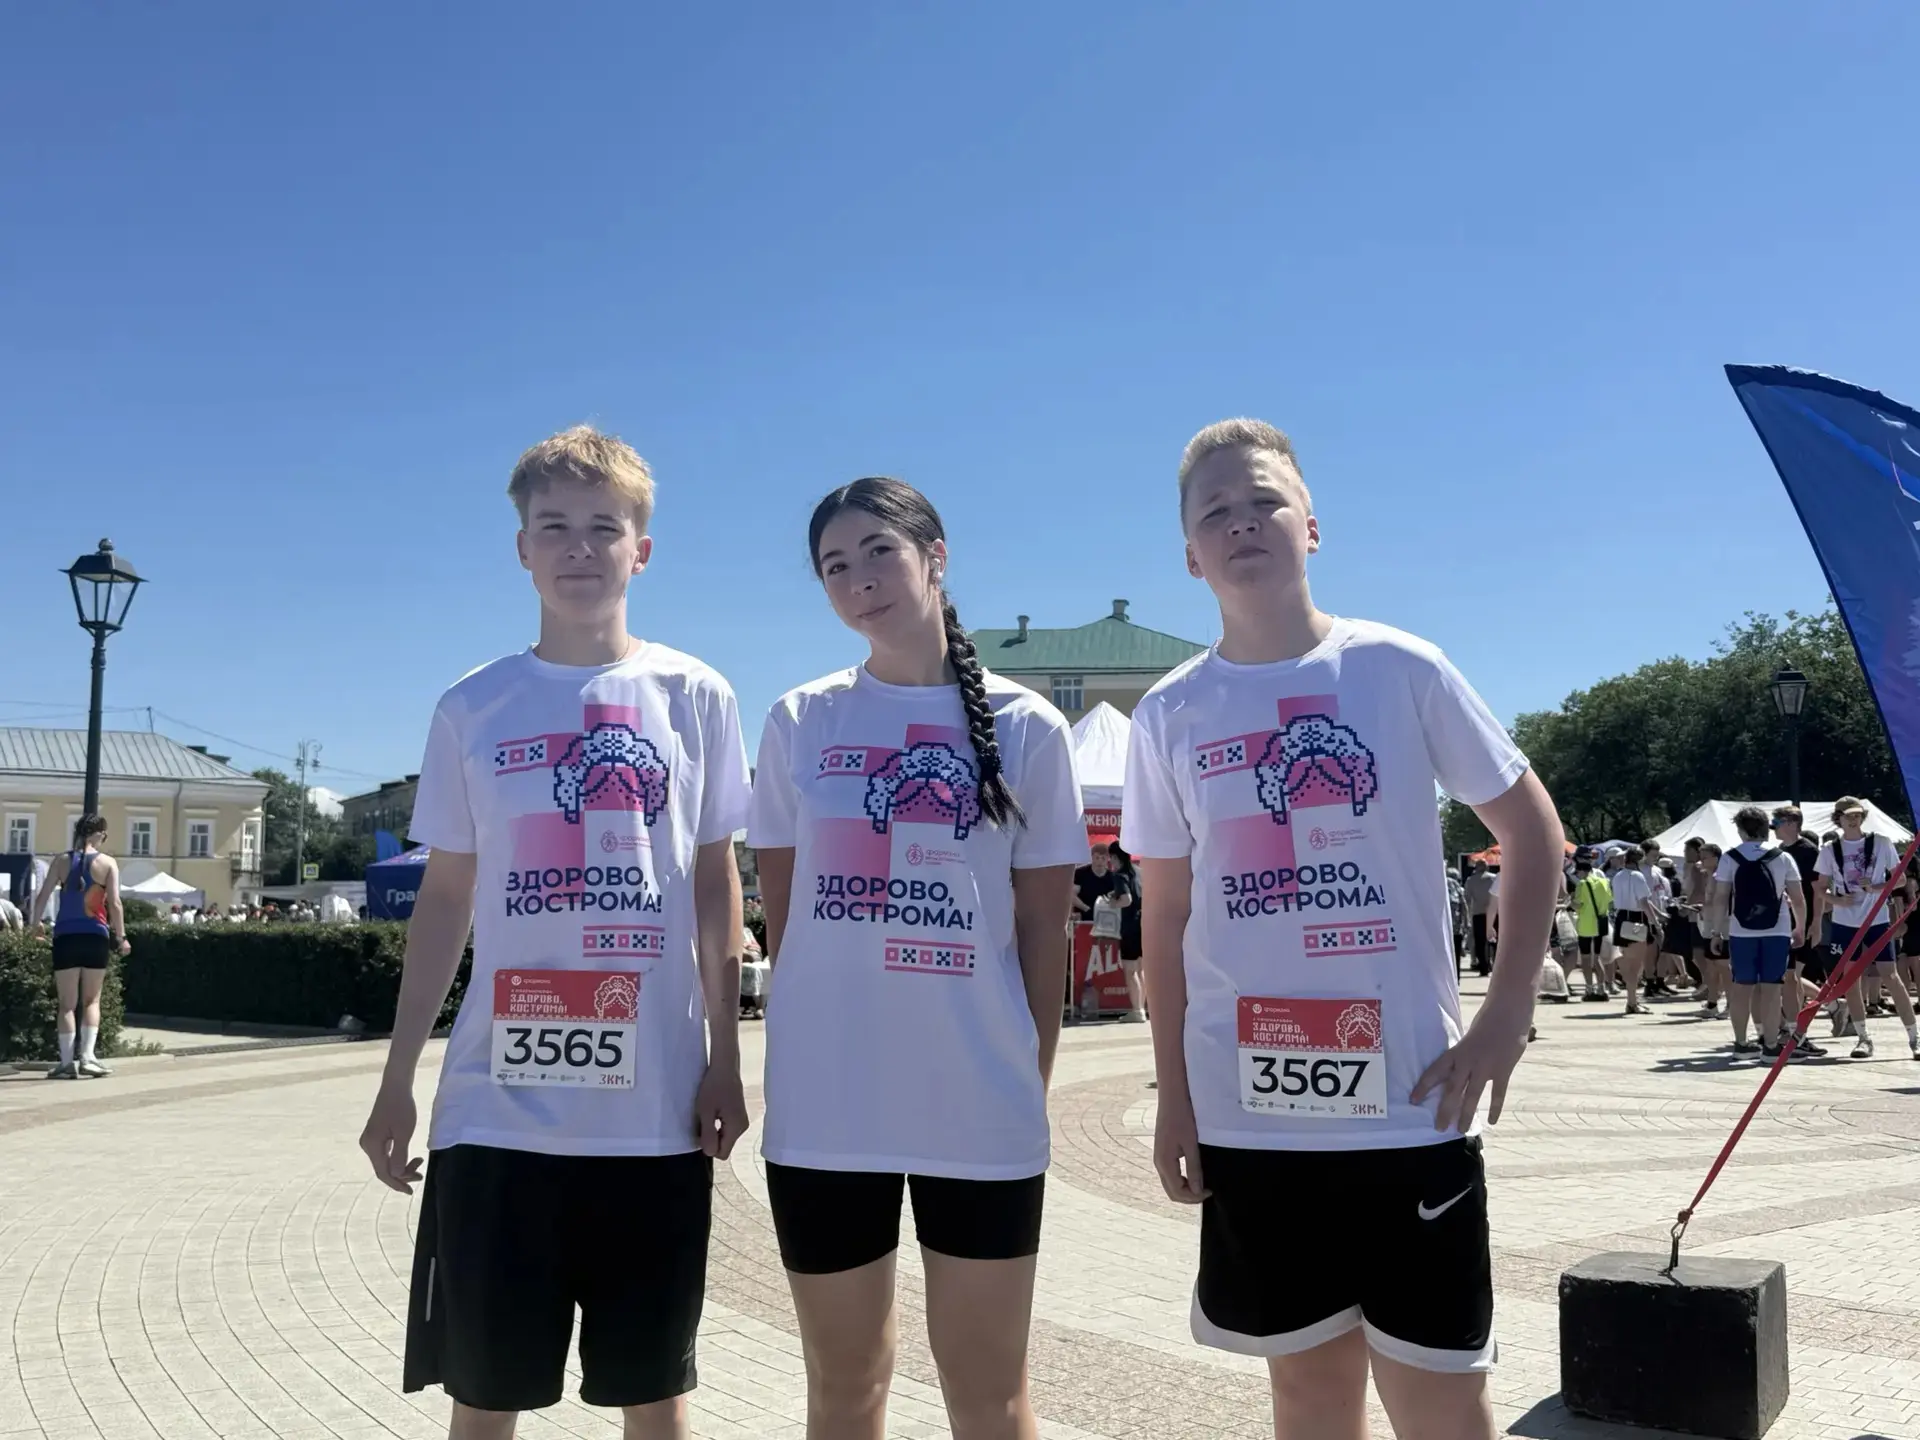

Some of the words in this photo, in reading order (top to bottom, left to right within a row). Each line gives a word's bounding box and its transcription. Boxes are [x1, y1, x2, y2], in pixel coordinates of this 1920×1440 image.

[505, 866, 649, 894] ЗДОРОВО,
[816, 874, 955, 907] ЗДОРОВО,
[1221, 861, 1367, 897] ЗДОРОВО,
[506, 891, 663, 917] КОСТРОМА!
[813, 899, 974, 931] КОСТРОМА!
[1226, 884, 1387, 920] КОСТРОМА!
[510, 1003, 568, 1014] КОСТРОМА!
[504, 1027, 625, 1068] 3565
[1252, 1031, 1310, 1044] КОСТРОМА!
[1251, 1055, 1371, 1098] 3567
